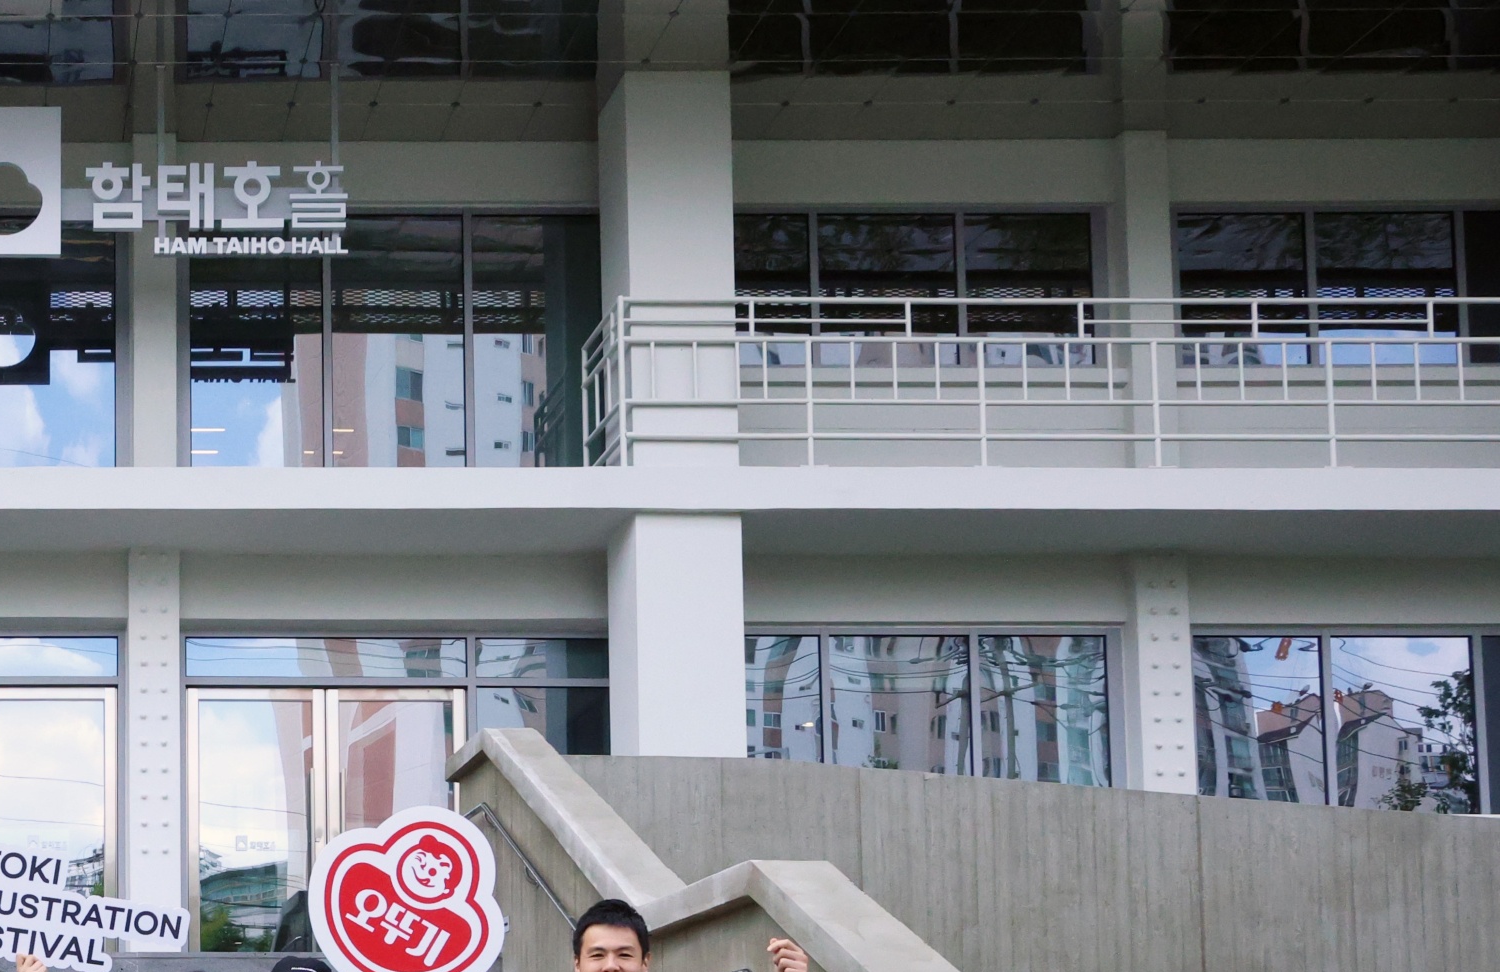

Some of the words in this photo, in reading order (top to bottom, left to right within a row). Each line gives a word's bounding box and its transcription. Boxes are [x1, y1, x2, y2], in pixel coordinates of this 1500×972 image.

[85, 161, 348, 230] 함태호홀
[154, 237, 207, 254] HAM
[213, 237, 285, 254] TAIHO
[291, 237, 348, 254] HALL
[345, 889, 451, 967] 오뚜기
